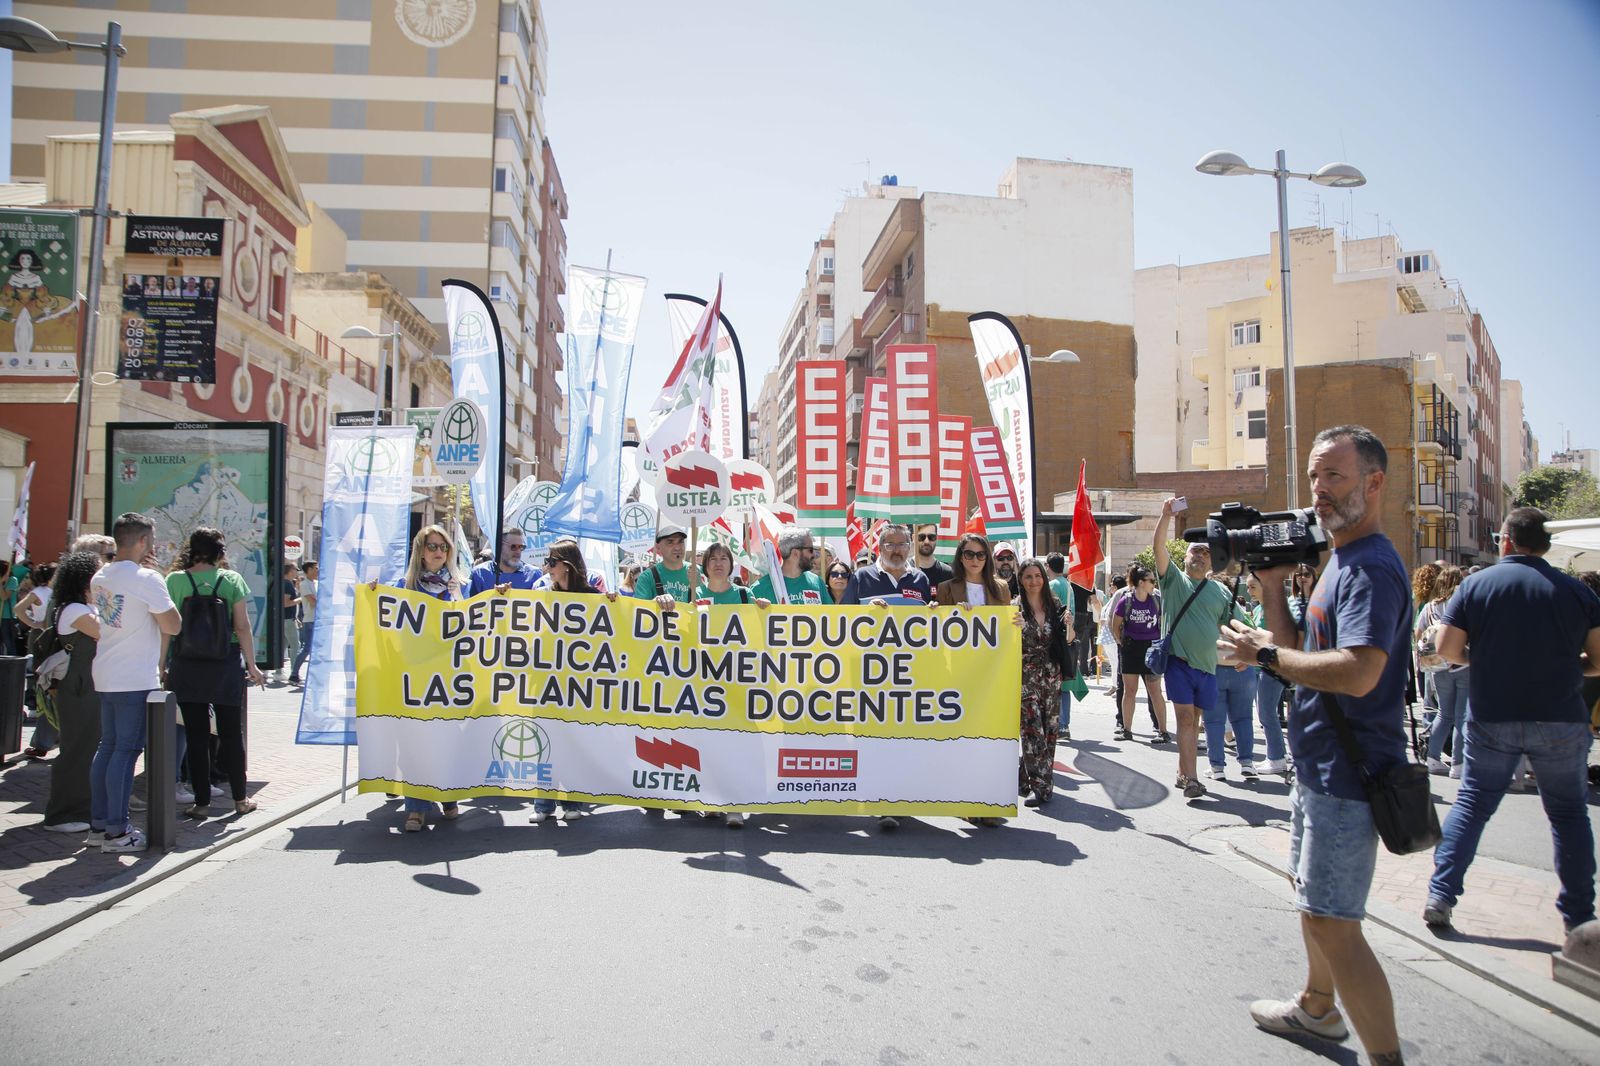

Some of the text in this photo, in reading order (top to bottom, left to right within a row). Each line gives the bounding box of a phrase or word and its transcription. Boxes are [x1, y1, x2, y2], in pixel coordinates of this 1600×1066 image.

[177, 248, 211, 257] 2024
[128, 318, 145, 328] 07
[126, 328, 145, 338] 08
[126, 338, 144, 347] 09
[127, 348, 140, 358] 10
[124, 358, 142, 368] 20
[173, 422, 208, 430] JCDecaux
[896, 352, 932, 492] CCOO
[805, 368, 838, 505] CCOO
[436, 443, 480, 462] ANPE
[970, 430, 1016, 520] CCOO
[335, 475, 402, 493] ANPE
[667, 491, 721, 507] USTEA
[621, 527, 656, 541] ANPE
[379, 595, 997, 648] EN DEFENSA DE LA EDUCACIÓN
[453, 631, 913, 686] PÚBLICA: AUMENTO DE
[404, 673, 962, 723] LAS PLANTILLAS DOCENTES
[486, 761, 553, 782] ANPE
[782, 756, 839, 771] CCOO
[632, 769, 701, 793] USTEA
[777, 780, 857, 793] enseñanza
